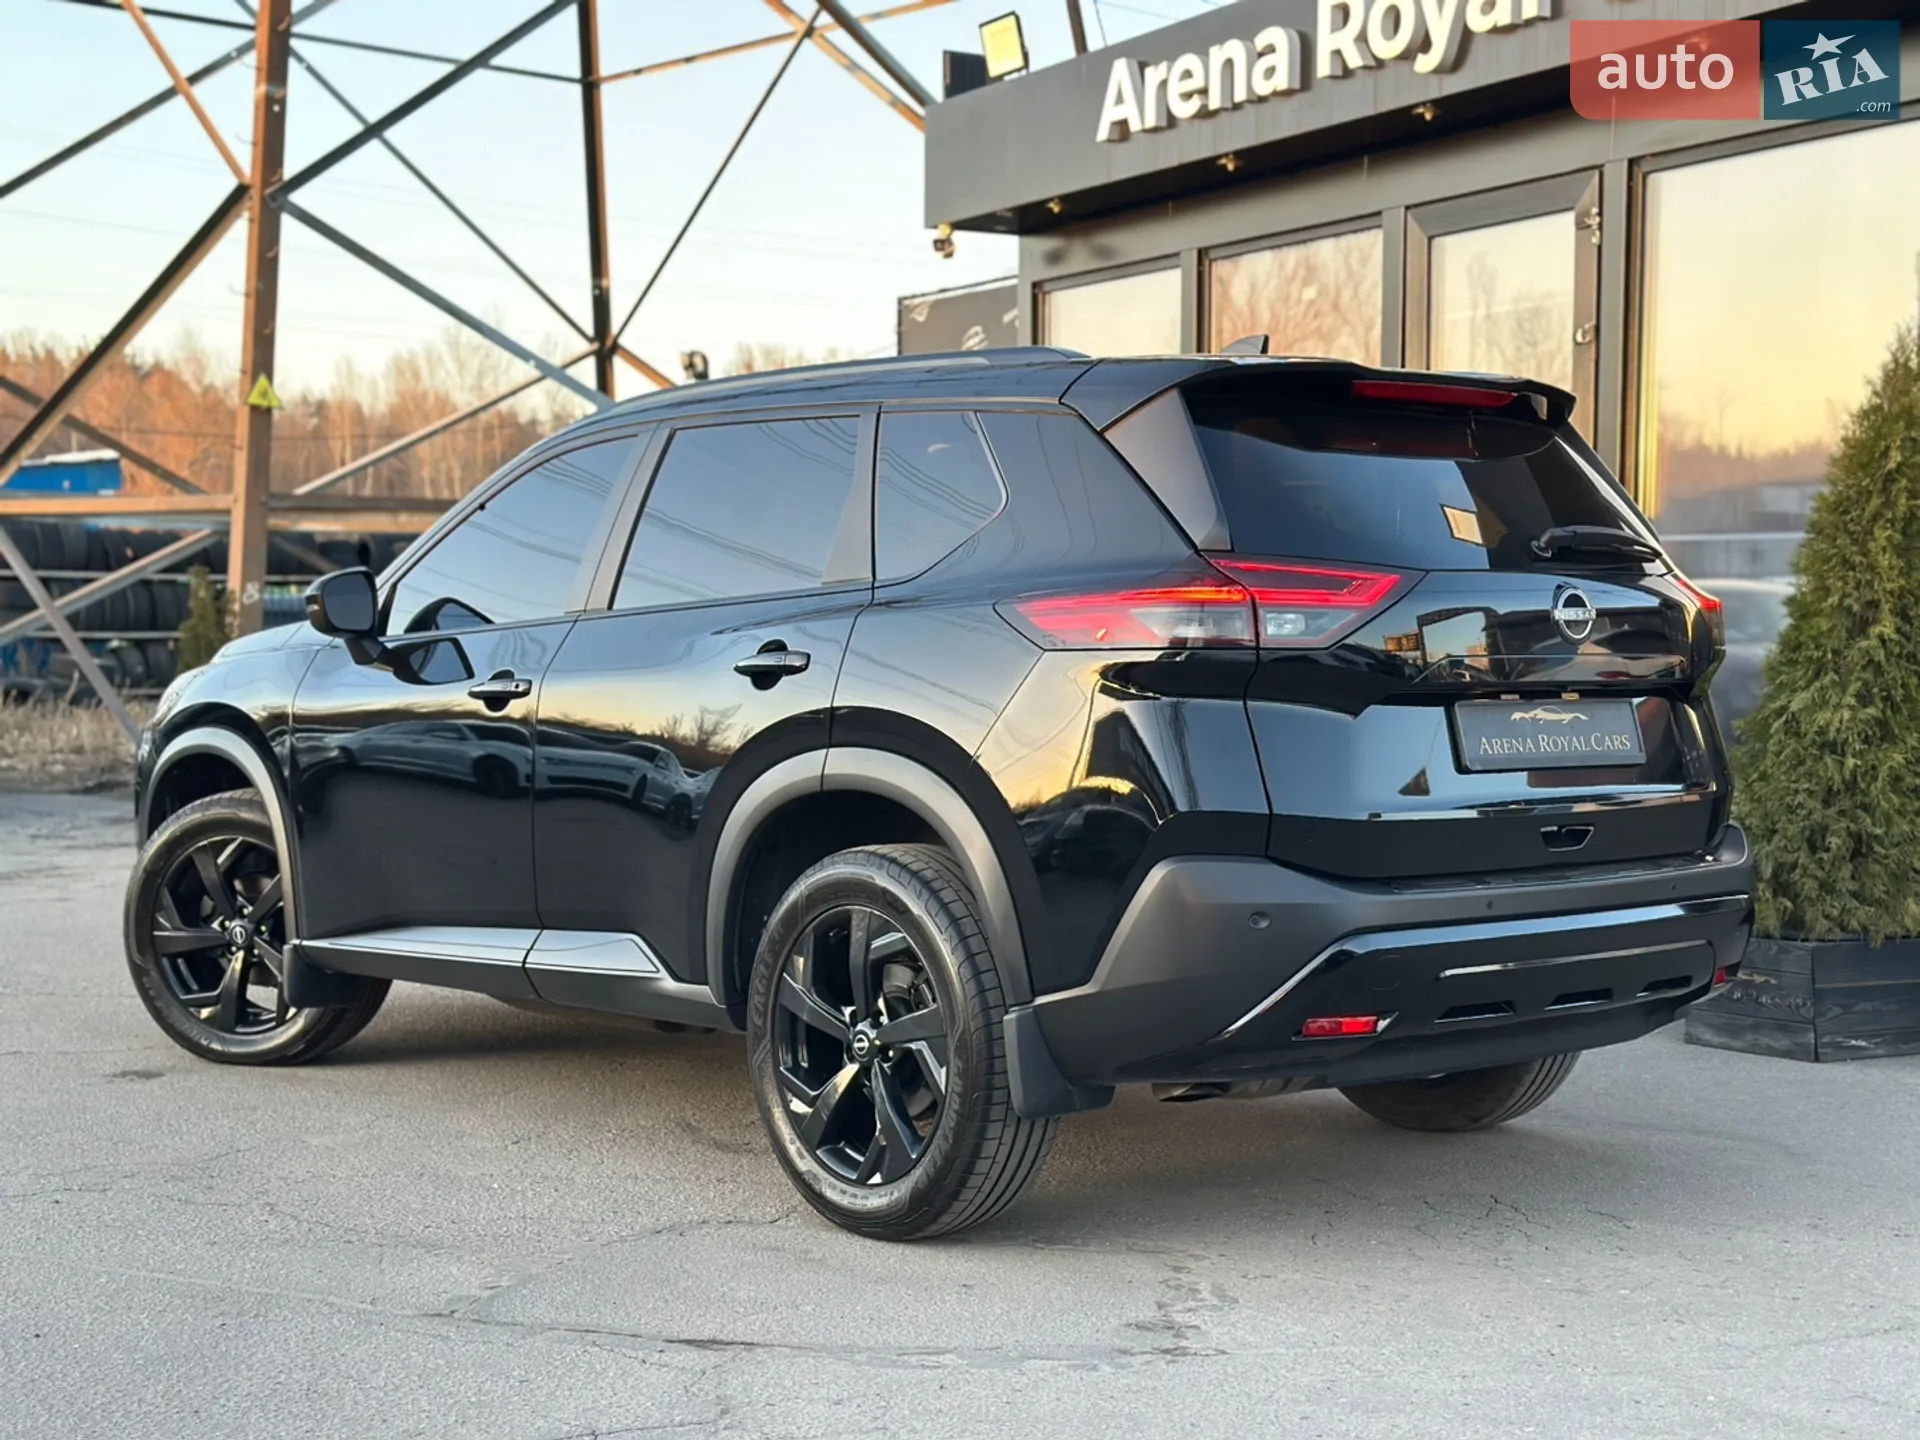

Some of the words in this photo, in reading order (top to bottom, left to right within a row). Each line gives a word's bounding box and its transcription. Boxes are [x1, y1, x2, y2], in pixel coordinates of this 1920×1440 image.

[1096, 25, 1297, 142] Arena
[1316, 0, 1545, 74] Roya
[1555, 609, 1596, 620] NISSAN
[1480, 736, 1536, 755] ARENA
[1538, 733, 1590, 752] ROYAL
[1591, 732, 1631, 750] CARS
